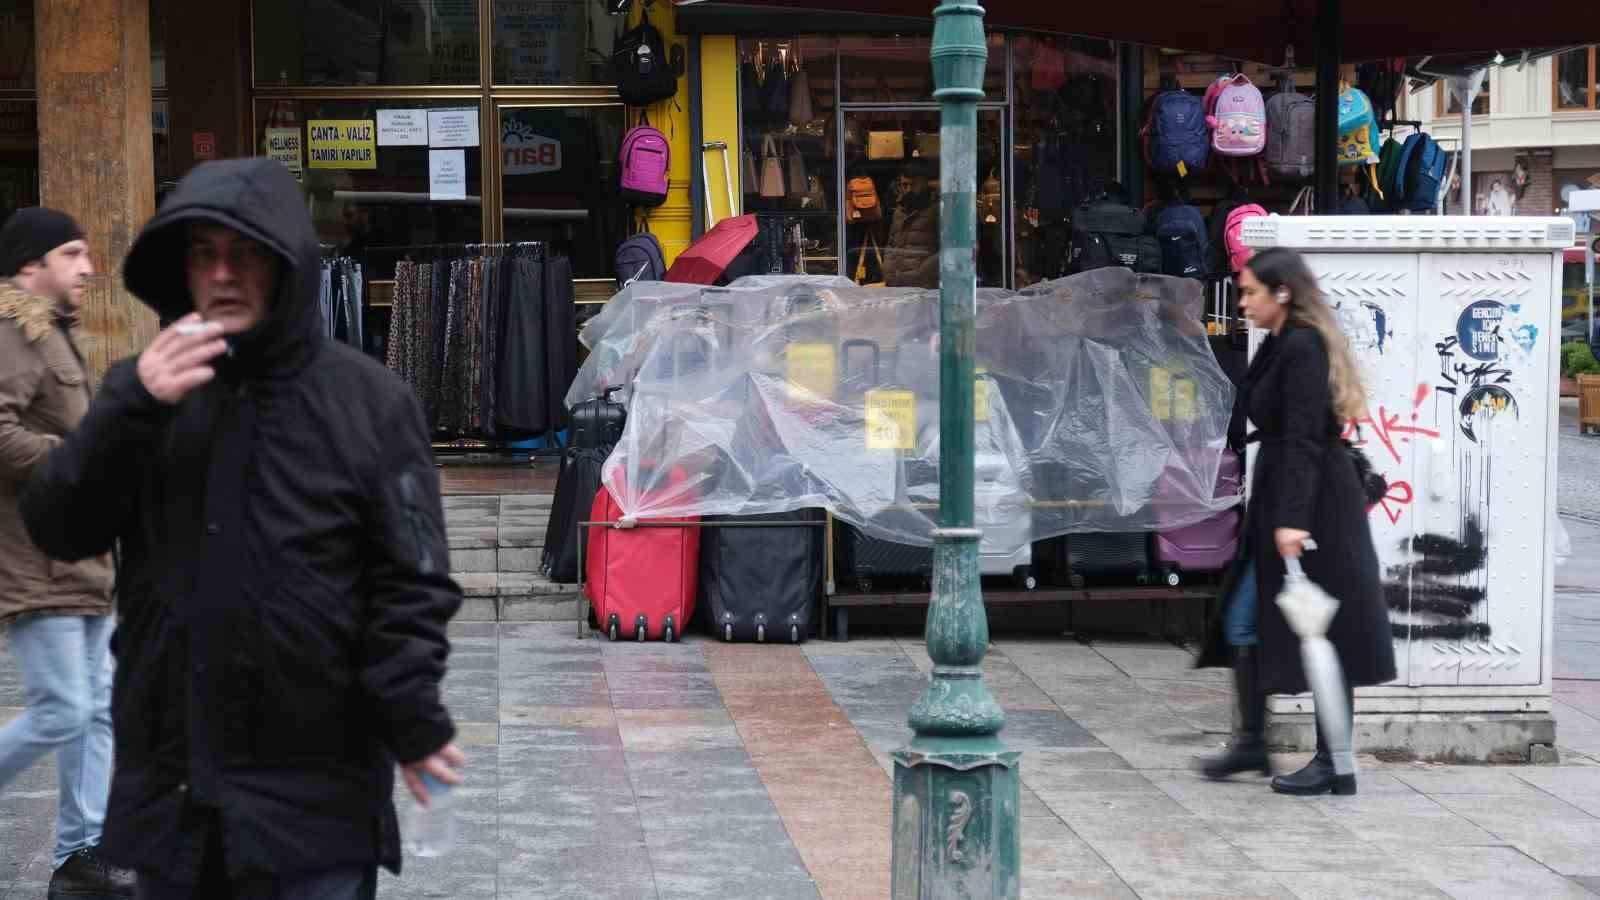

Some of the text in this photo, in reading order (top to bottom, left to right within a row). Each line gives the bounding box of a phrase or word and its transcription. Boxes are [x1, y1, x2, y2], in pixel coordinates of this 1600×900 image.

[311, 127, 339, 144] ÇANTA
[311, 146, 371, 161] TAMİRİ YAPILIR
